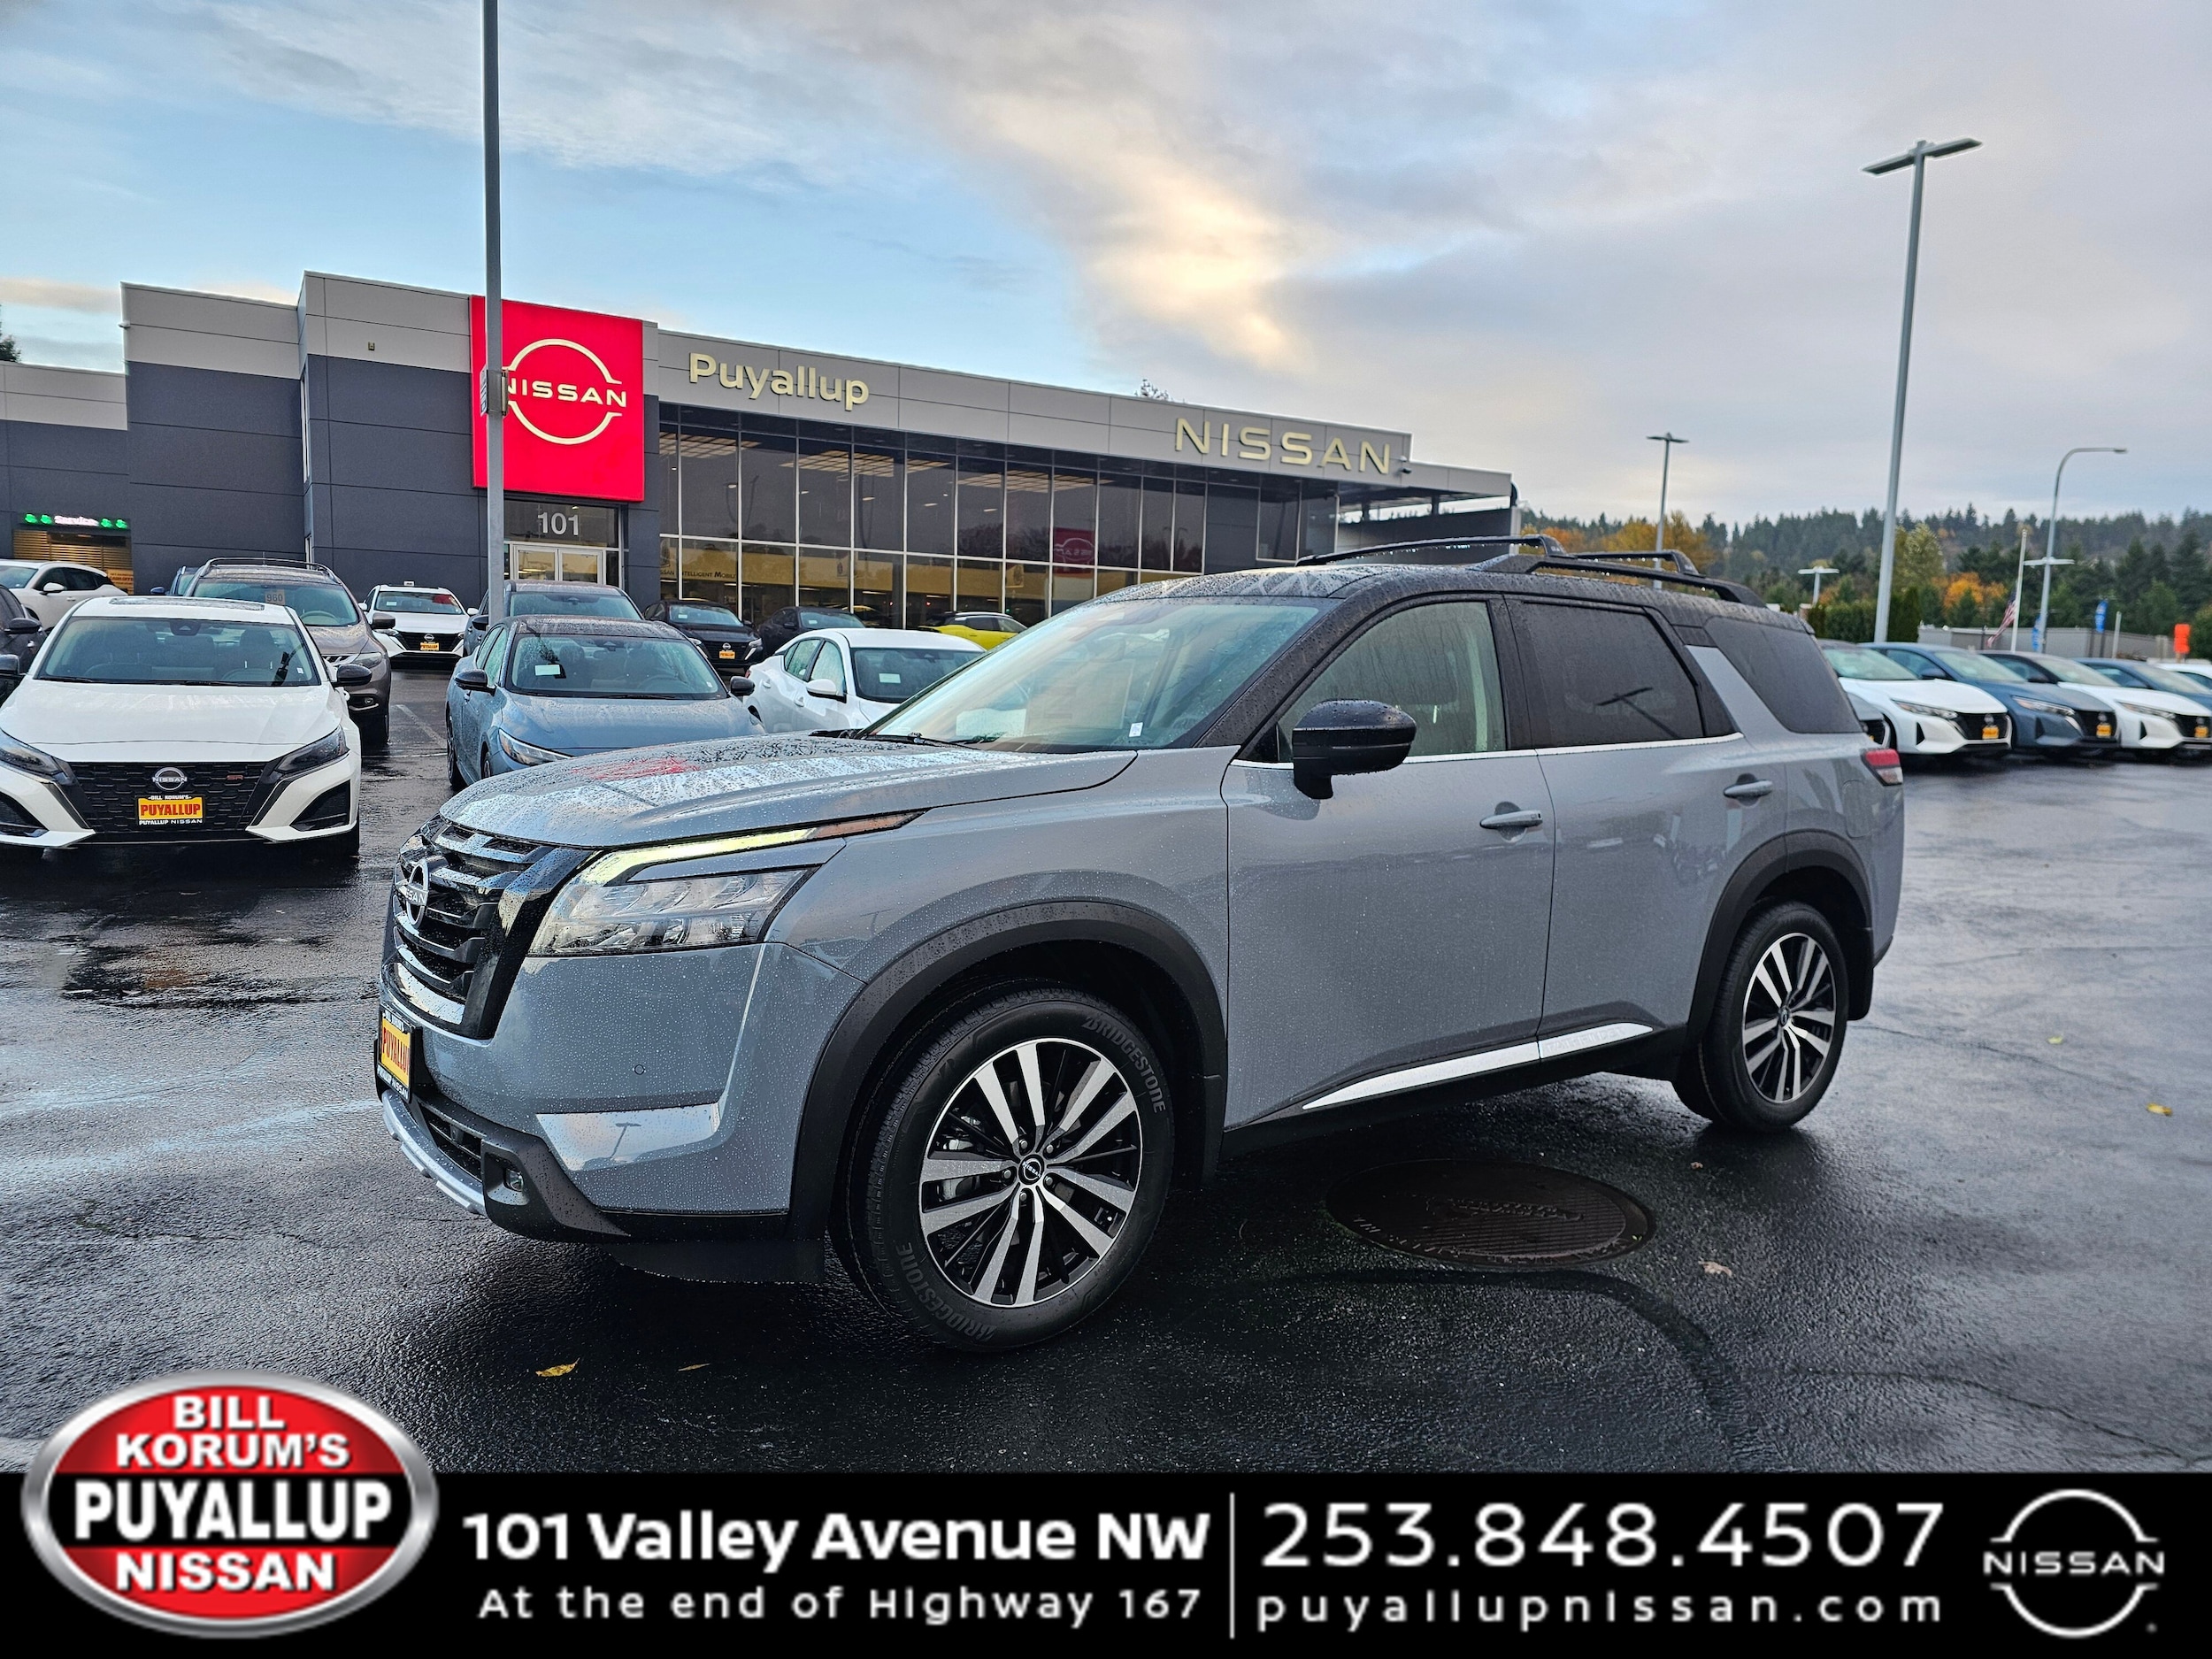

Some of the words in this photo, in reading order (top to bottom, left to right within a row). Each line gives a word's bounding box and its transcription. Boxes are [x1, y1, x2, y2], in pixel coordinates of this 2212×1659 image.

[689, 352, 869, 411] Puyallup
[1174, 418, 1390, 474] NISSAN
[538, 512, 579, 535] 101
[141, 803, 201, 816] PUYALLUP
[1081, 1015, 1166, 1113] BRIDGESTONE
[895, 1241, 997, 1341] BRIDGESTONE
